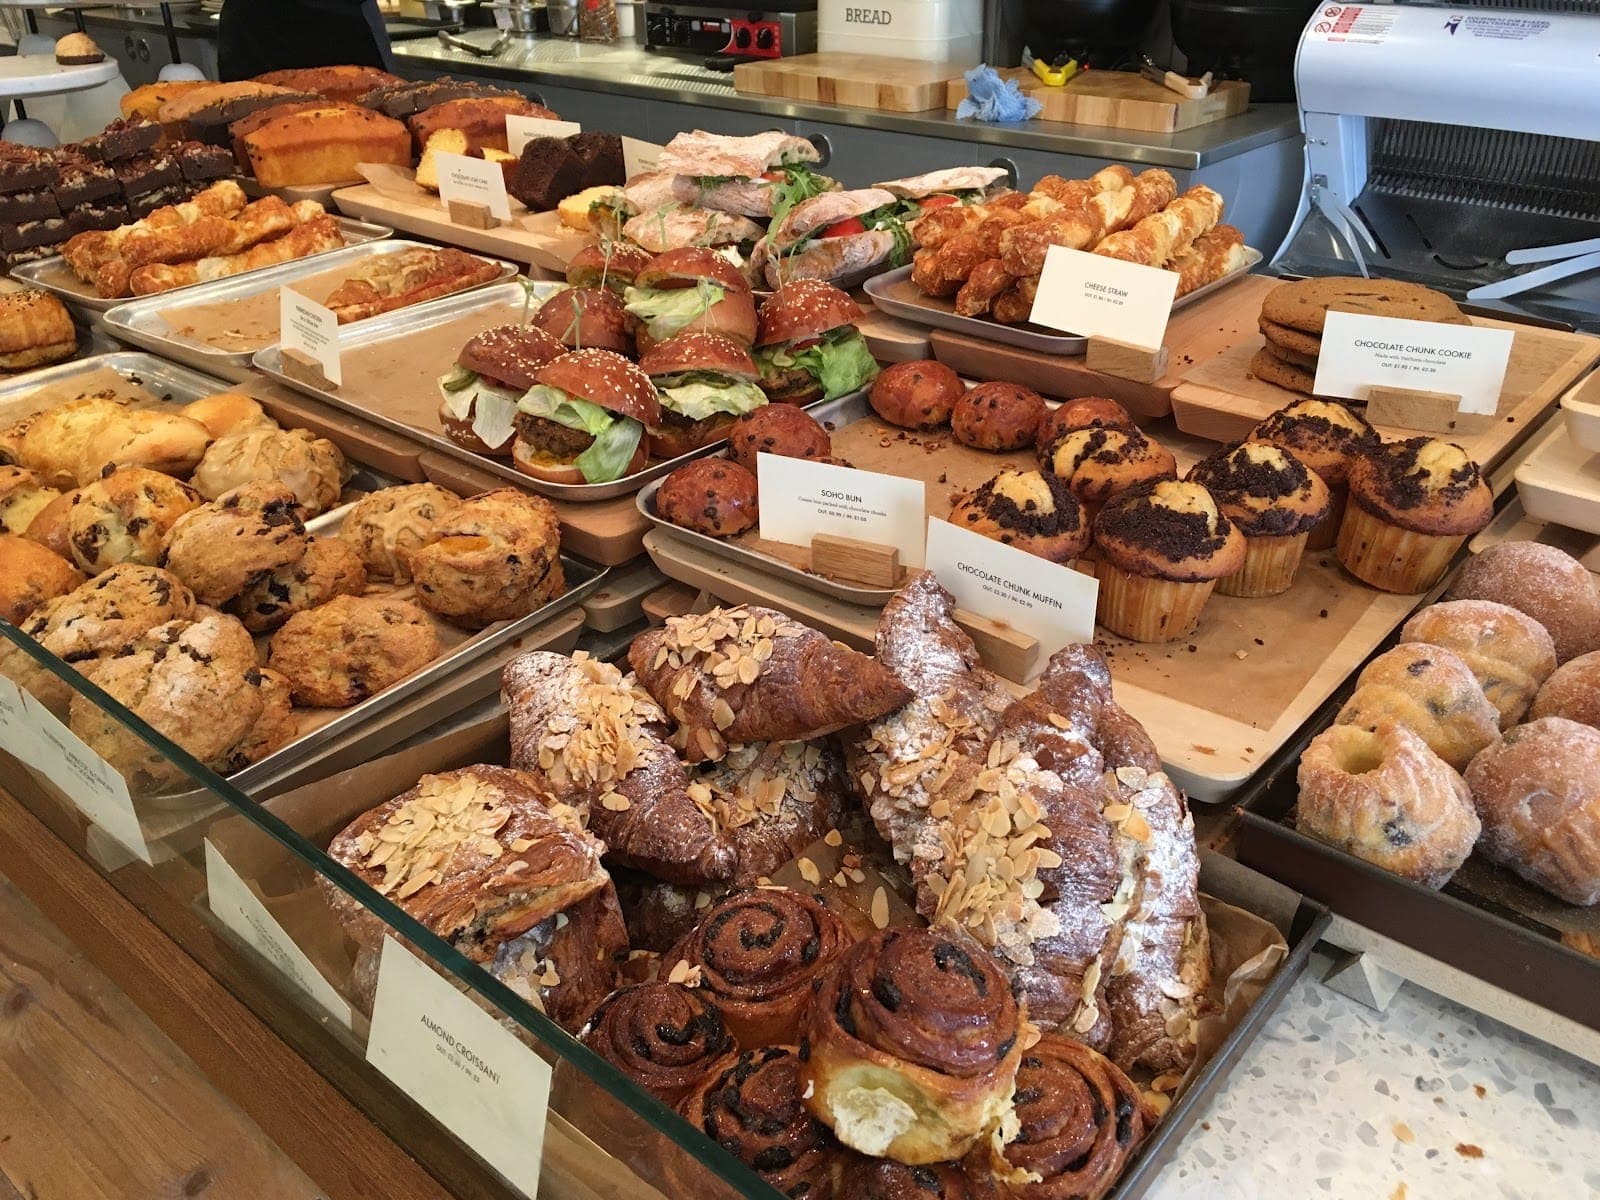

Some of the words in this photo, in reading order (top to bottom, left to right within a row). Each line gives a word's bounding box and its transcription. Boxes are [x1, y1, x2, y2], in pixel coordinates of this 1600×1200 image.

[845, 7, 892, 25] BREAD
[1085, 282, 1107, 293] CHEESE
[1108, 287, 1128, 297] STRAW
[1354, 339, 1404, 352] CHOCOLATE
[1405, 345, 1436, 356] CHUNK
[1438, 349, 1473, 360] COOKIE
[821, 489, 844, 500] SOHO
[845, 494, 862, 503] BUN
[957, 562, 1002, 586] CHOCOLATE
[1003, 580, 1031, 597] CHUNK
[1032, 592, 1063, 610] MUFFIN
[421, 1014, 454, 1046] ALMOND
[455, 1042, 502, 1085] CROISSANT
